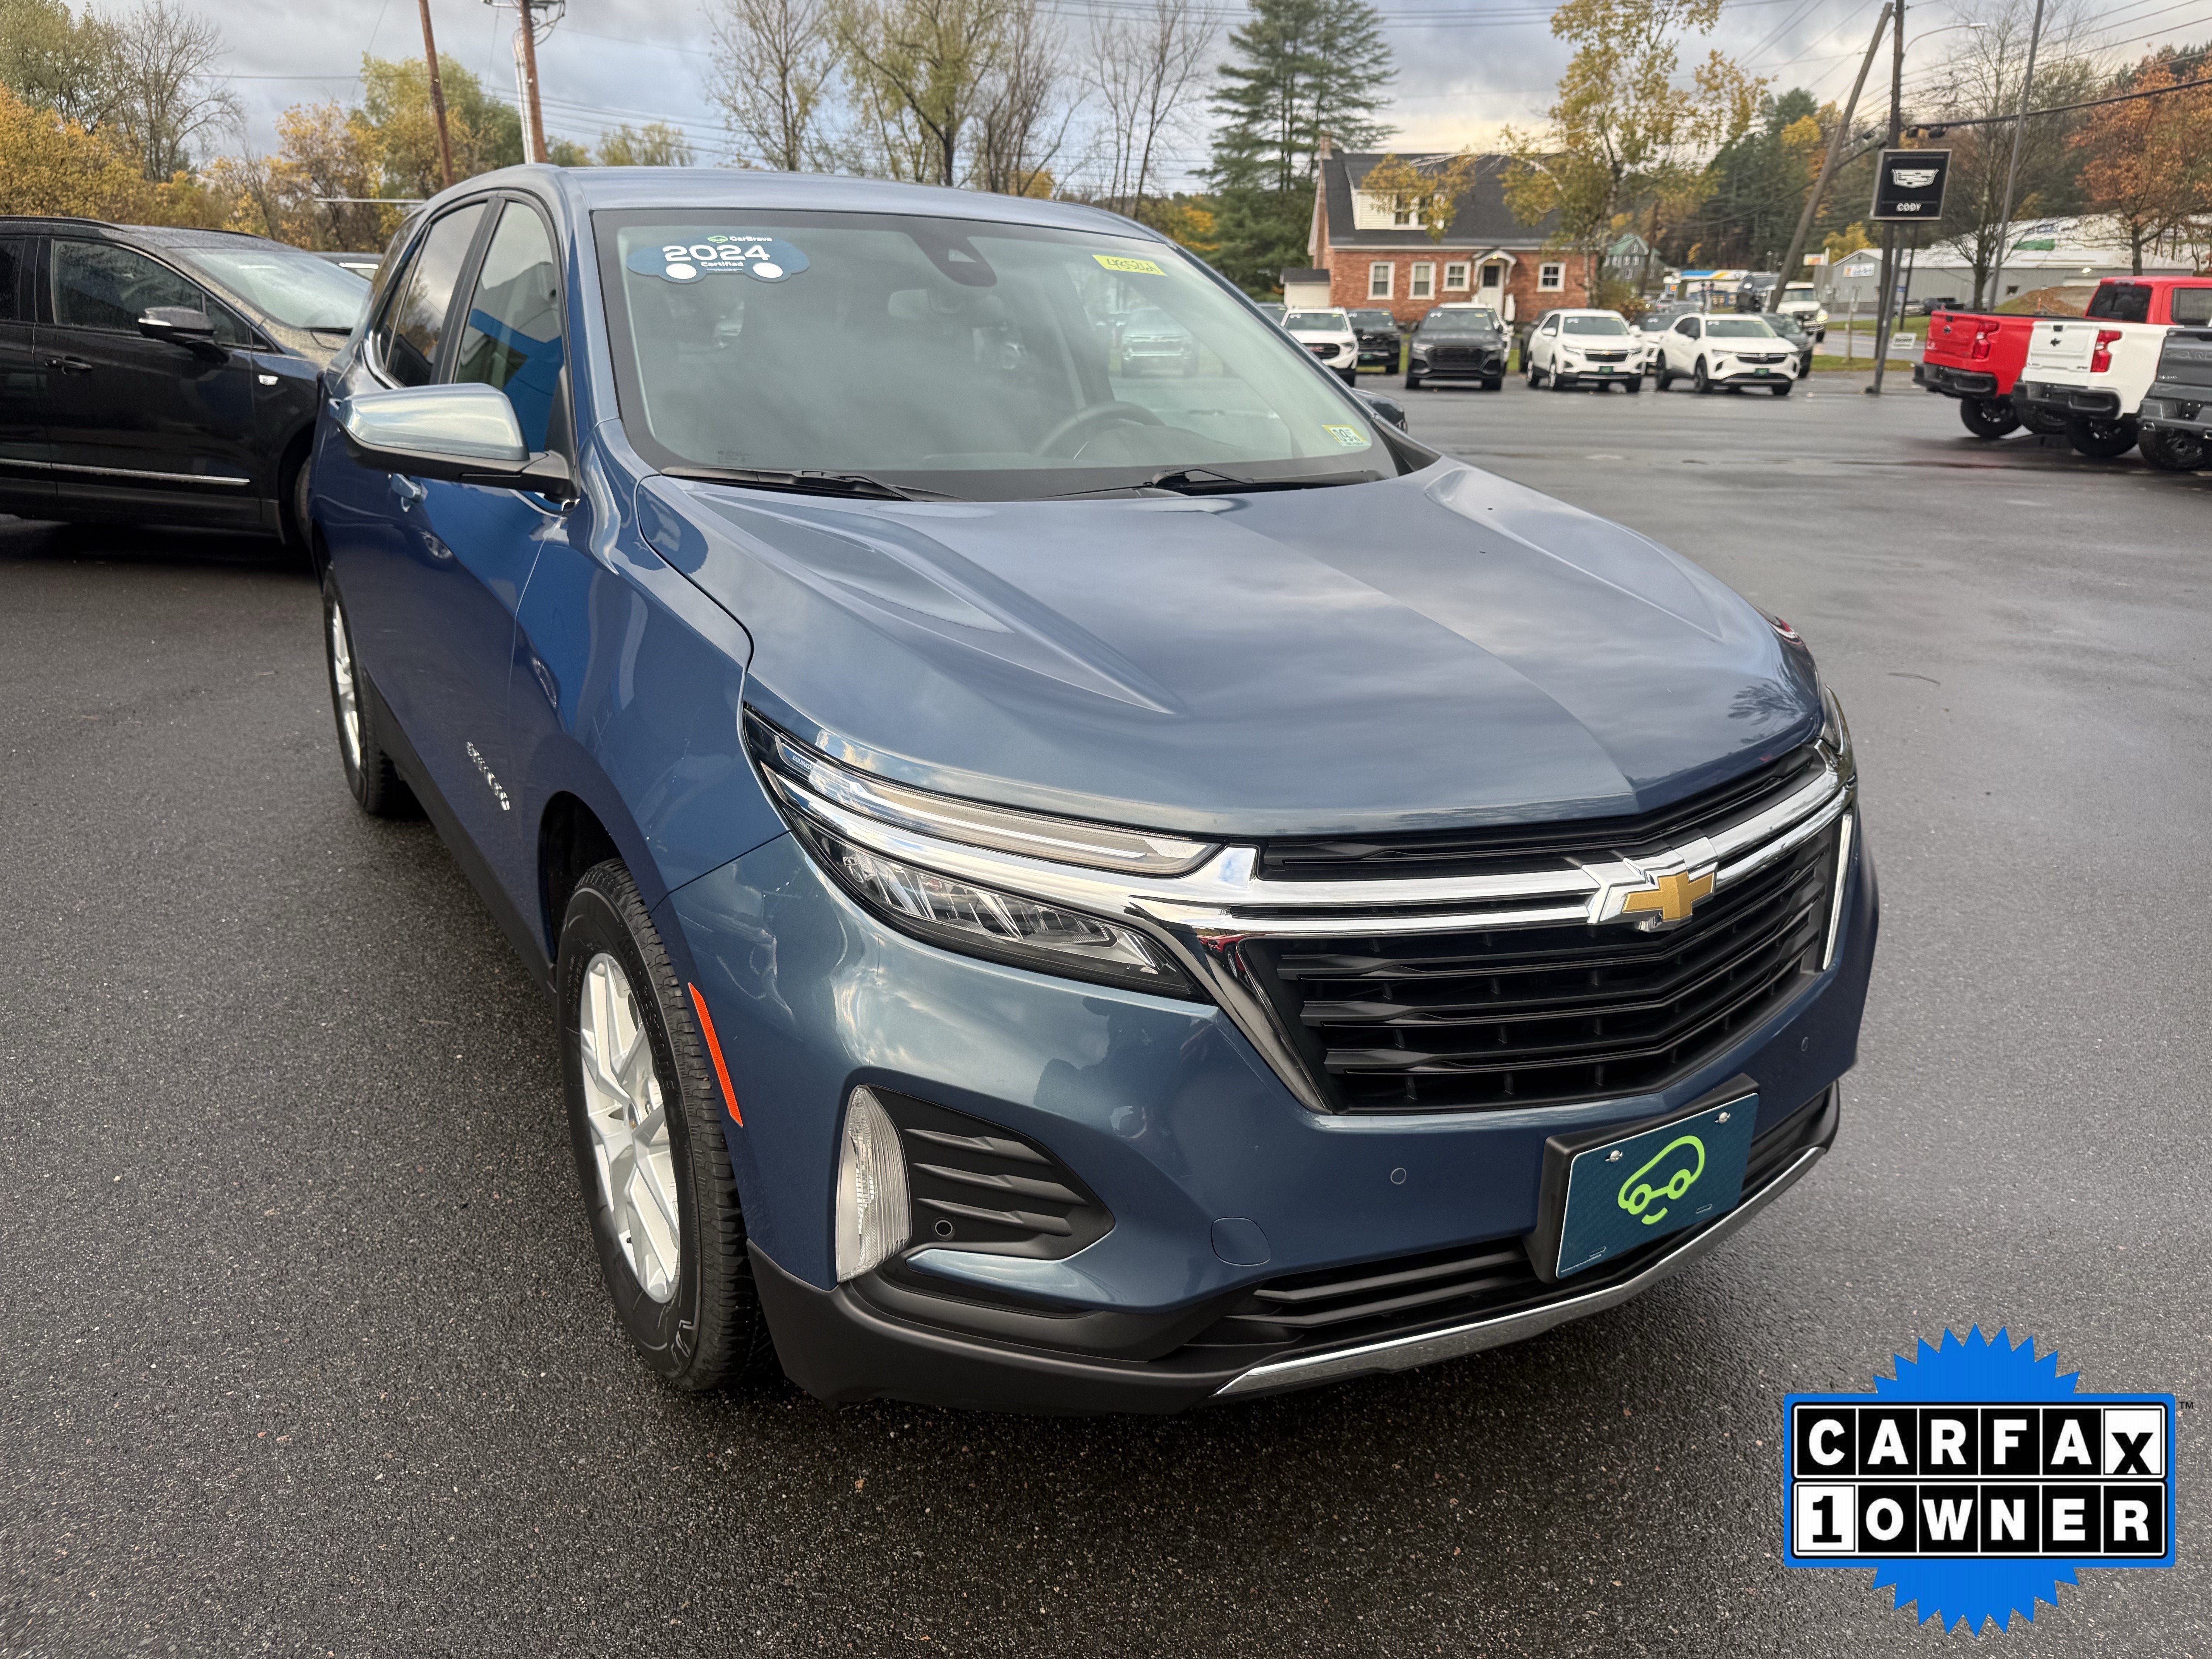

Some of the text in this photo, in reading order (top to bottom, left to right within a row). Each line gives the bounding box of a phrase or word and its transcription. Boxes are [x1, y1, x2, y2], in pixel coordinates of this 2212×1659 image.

[1896, 203, 1922, 212] CODY
[662, 244, 771, 261] 2024
[792, 755, 813, 771] EQUINOX
